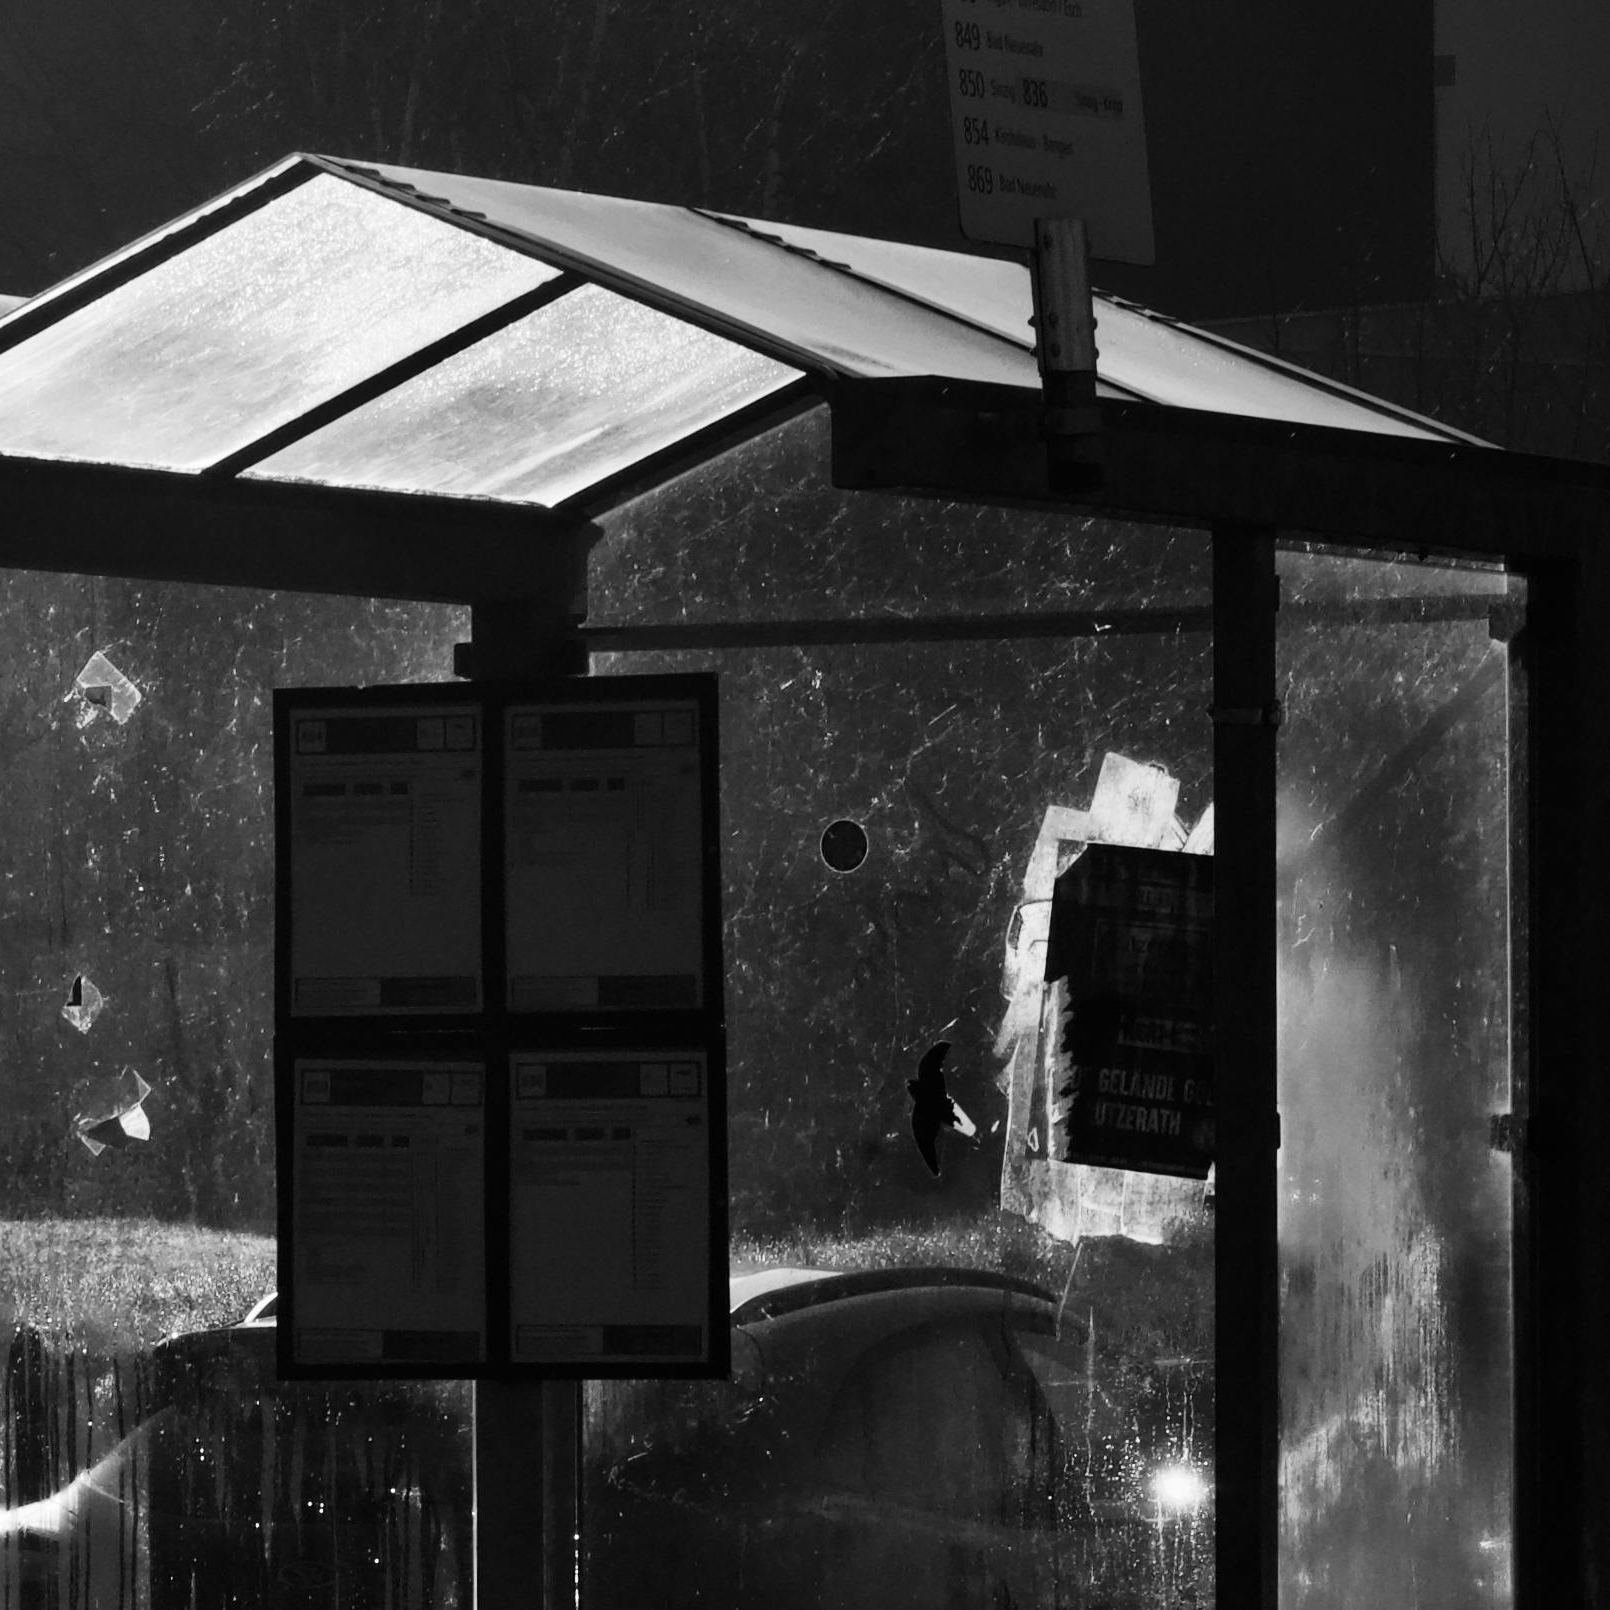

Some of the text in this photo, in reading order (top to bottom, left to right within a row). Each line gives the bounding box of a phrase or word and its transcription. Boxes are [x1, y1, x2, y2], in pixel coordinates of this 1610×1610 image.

[954, 20, 981, 51] 849
[958, 68, 986, 99] 850
[1022, 78, 1049, 108] 836
[963, 116, 990, 146] 854
[967, 164, 994, 195] 869
